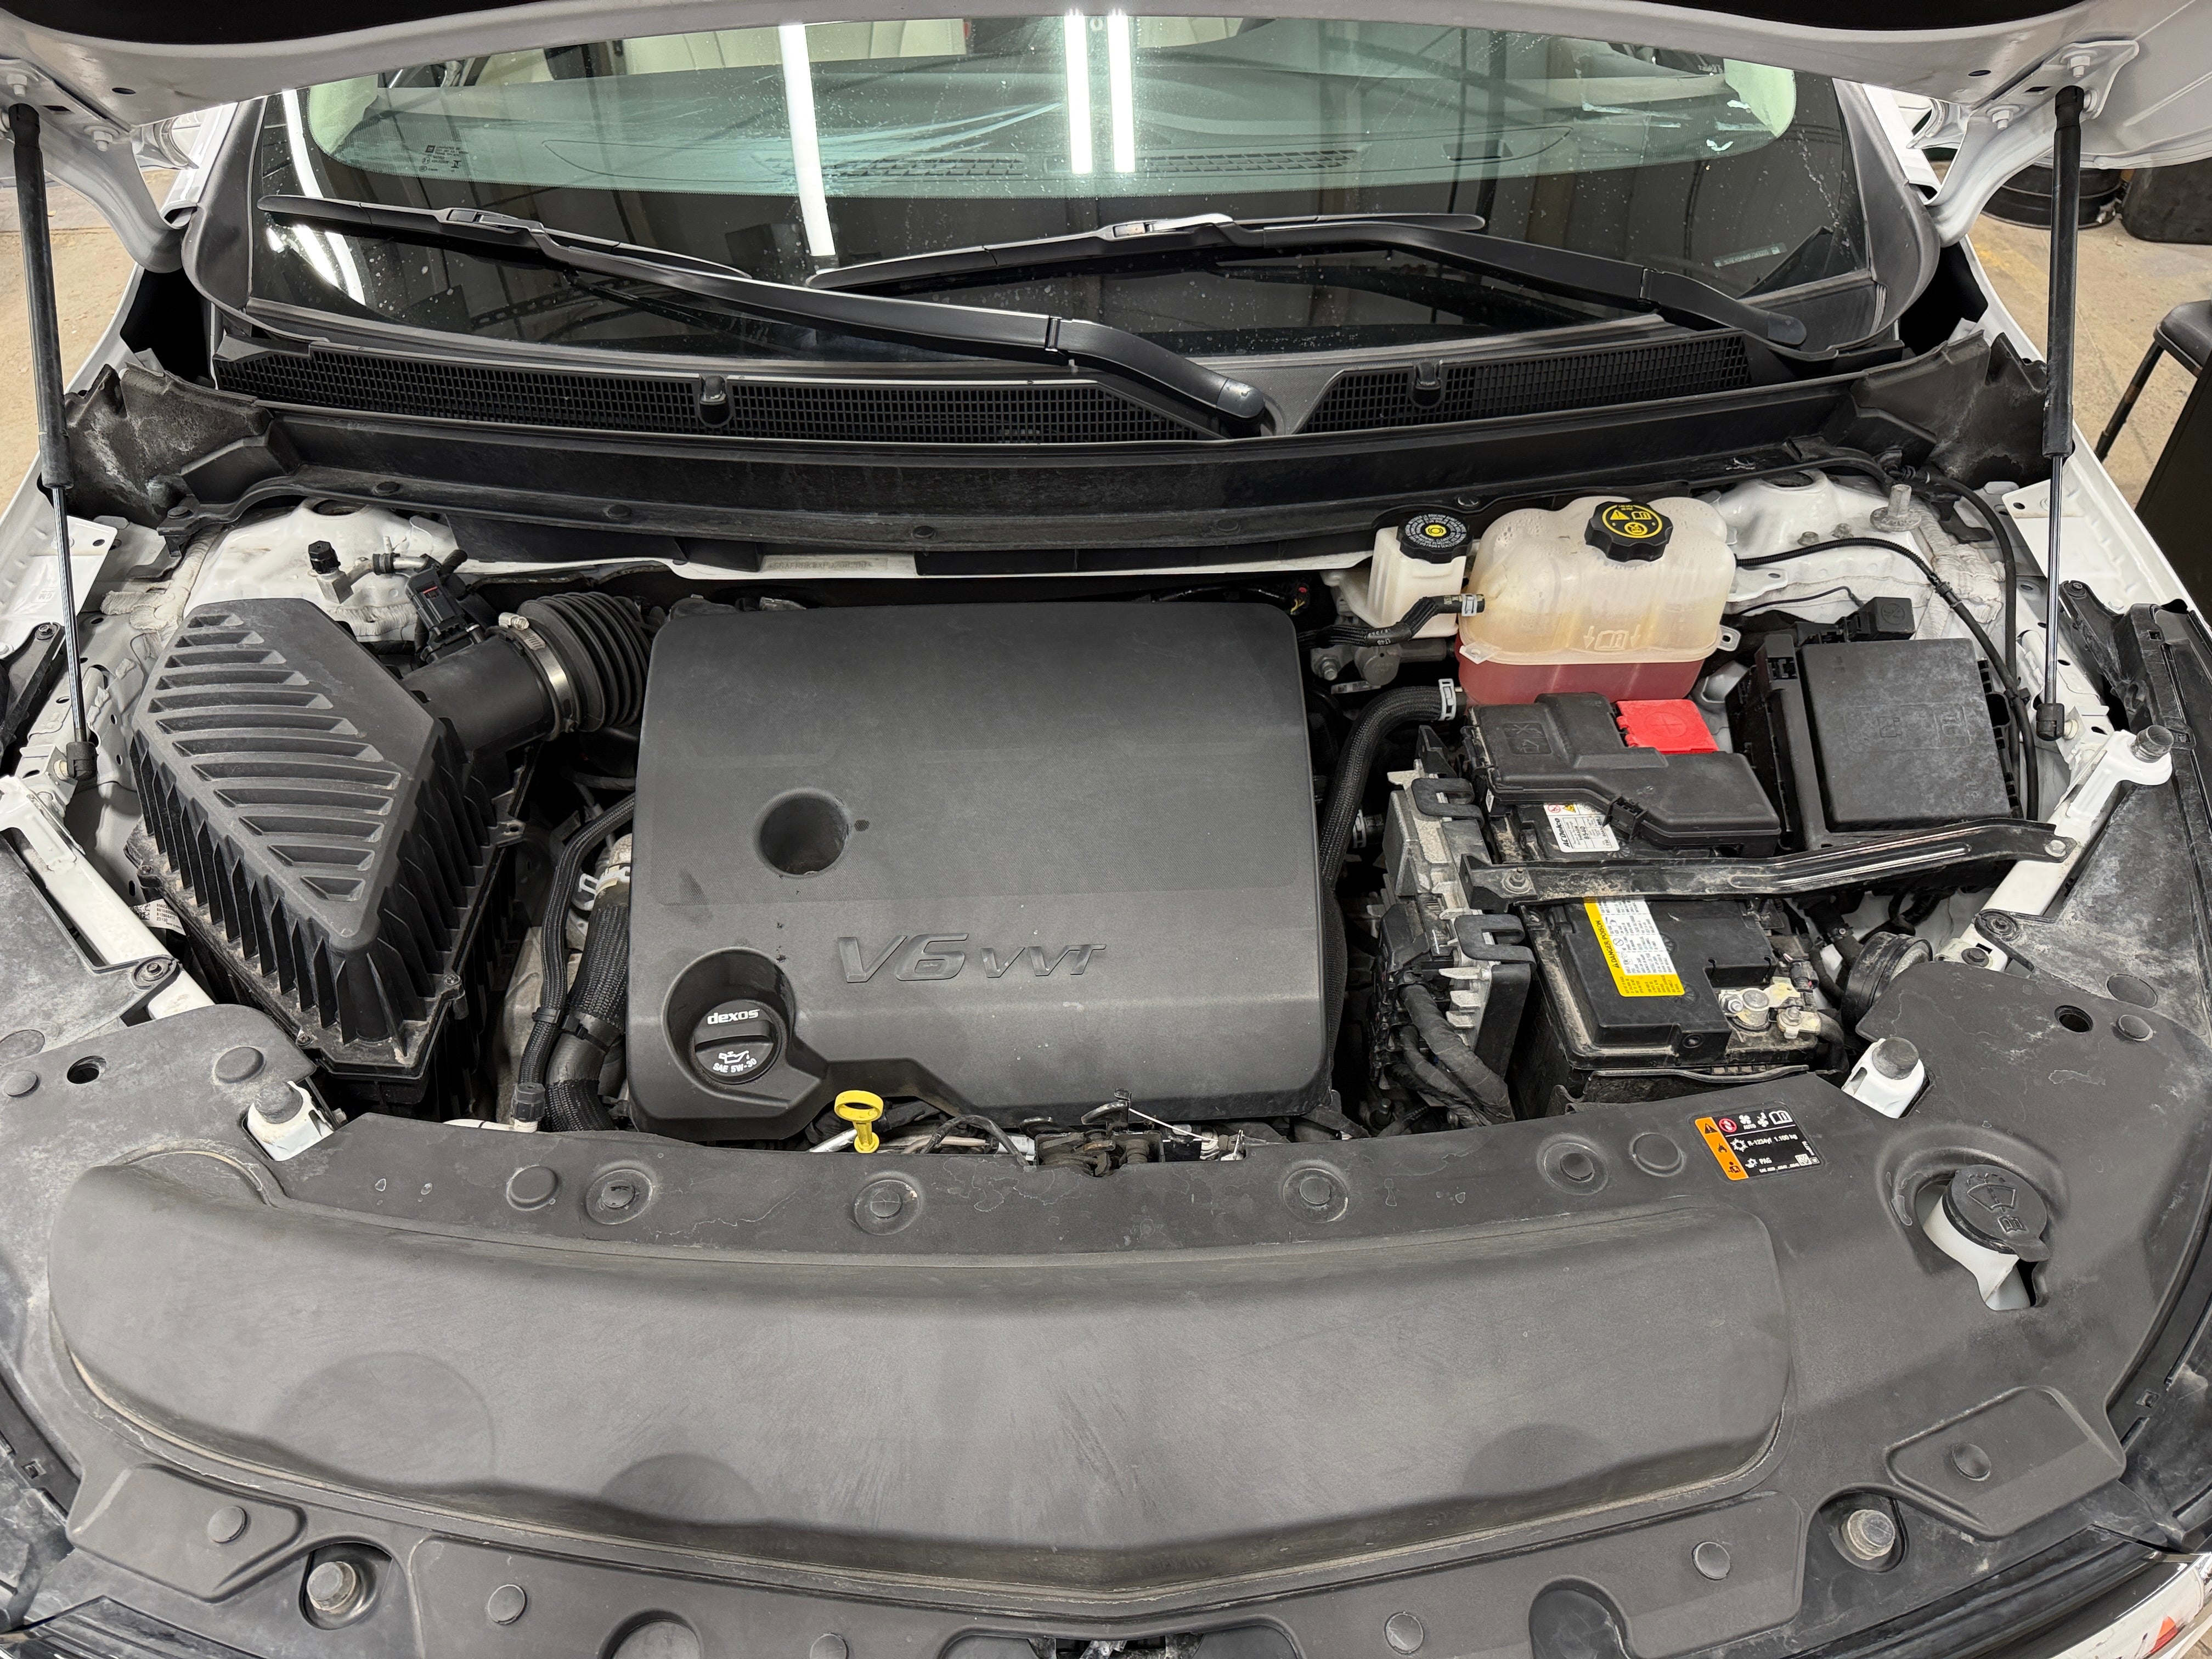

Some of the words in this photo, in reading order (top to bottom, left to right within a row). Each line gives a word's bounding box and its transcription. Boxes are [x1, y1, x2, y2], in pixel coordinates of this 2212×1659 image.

[1554, 818, 1571, 848] ACDelco
[837, 933, 969, 984] V6
[980, 944, 1107, 979] VVT
[707, 1009, 760, 1025] dexos
[713, 1063, 729, 1073] SAE
[730, 1058, 757, 1073] 5W-30
[1747, 1137, 1773, 1147] R-1234yf
[1774, 1134, 1790, 1142] 1.100
[1759, 1157, 1773, 1165] PAG
